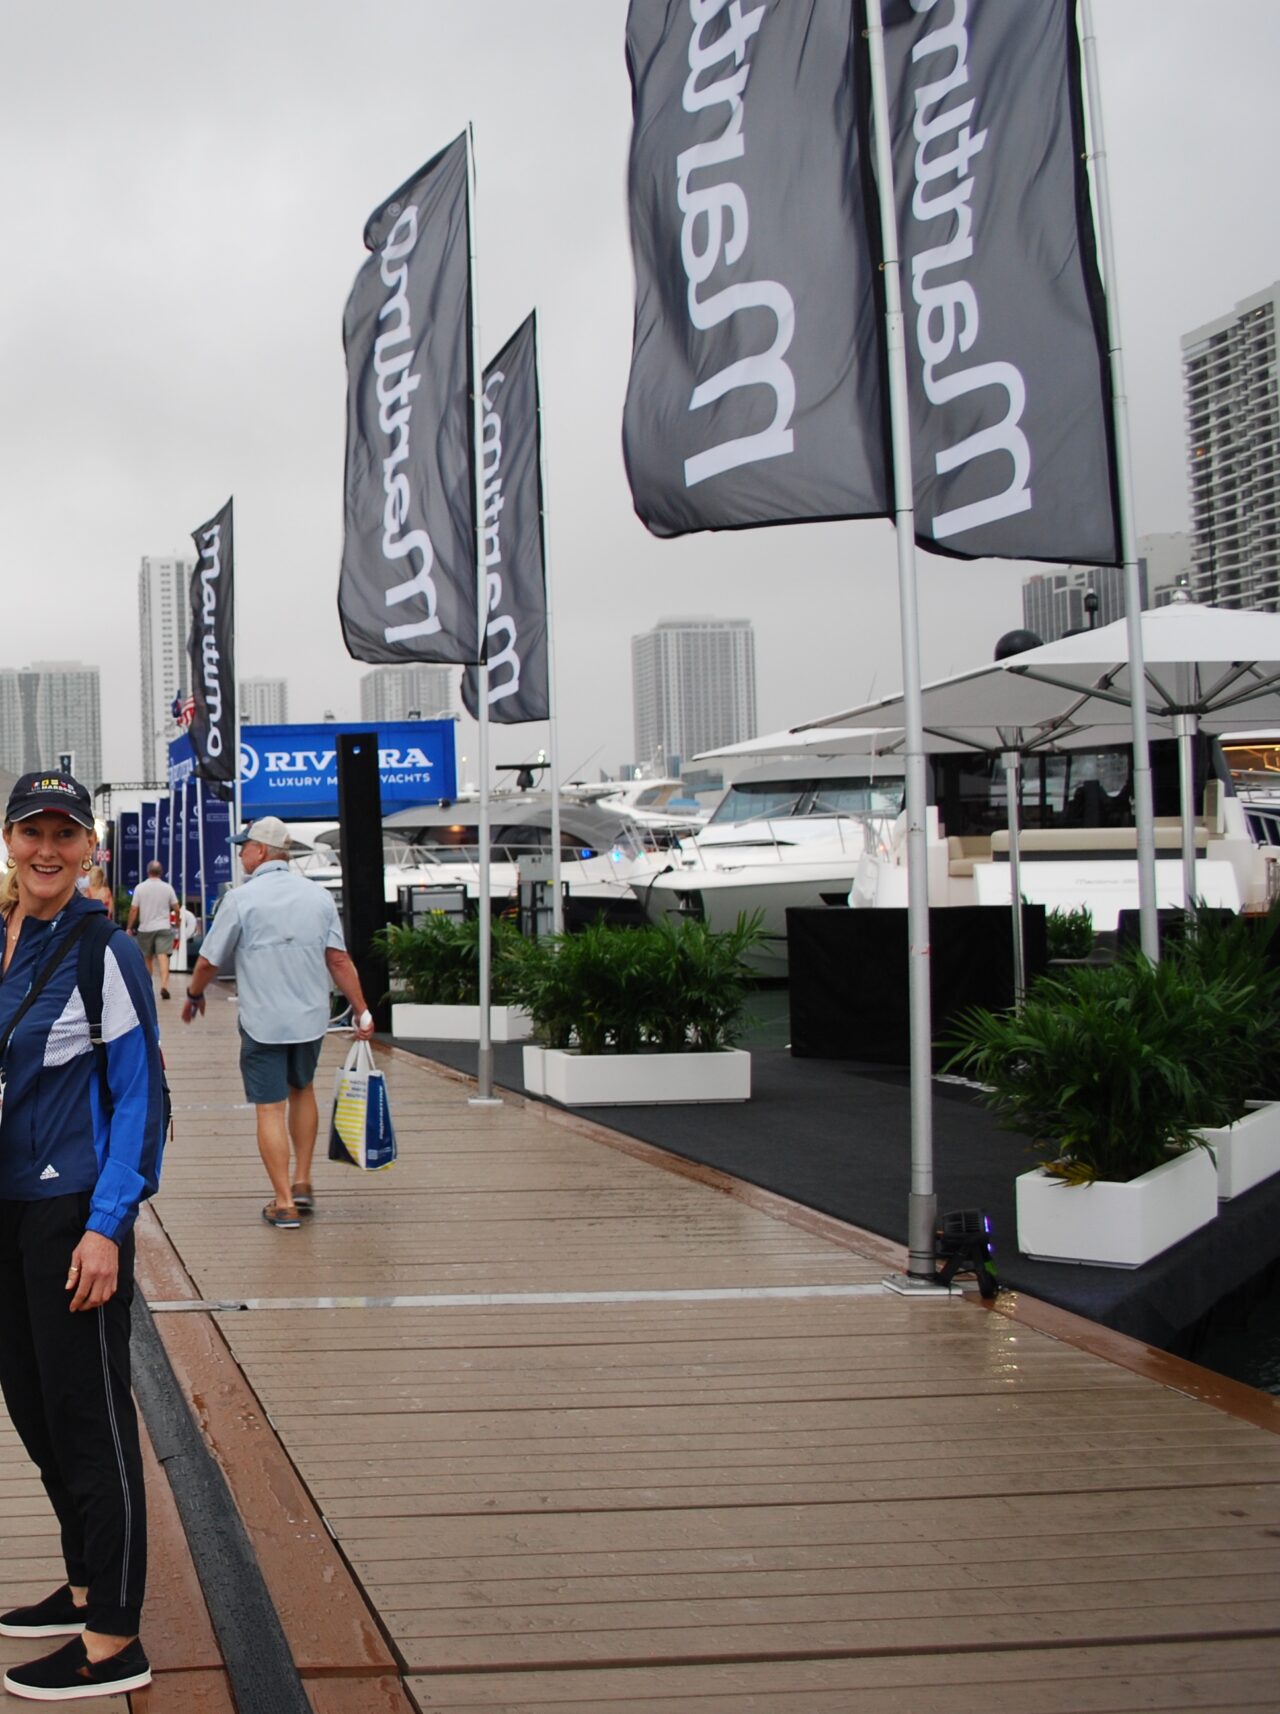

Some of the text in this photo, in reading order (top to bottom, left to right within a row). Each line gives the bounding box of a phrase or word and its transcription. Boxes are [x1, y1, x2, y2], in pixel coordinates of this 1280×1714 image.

[264, 748, 433, 773] RIVRA
[268, 776, 322, 788] LUXURY
[381, 772, 432, 784] YACHTS
